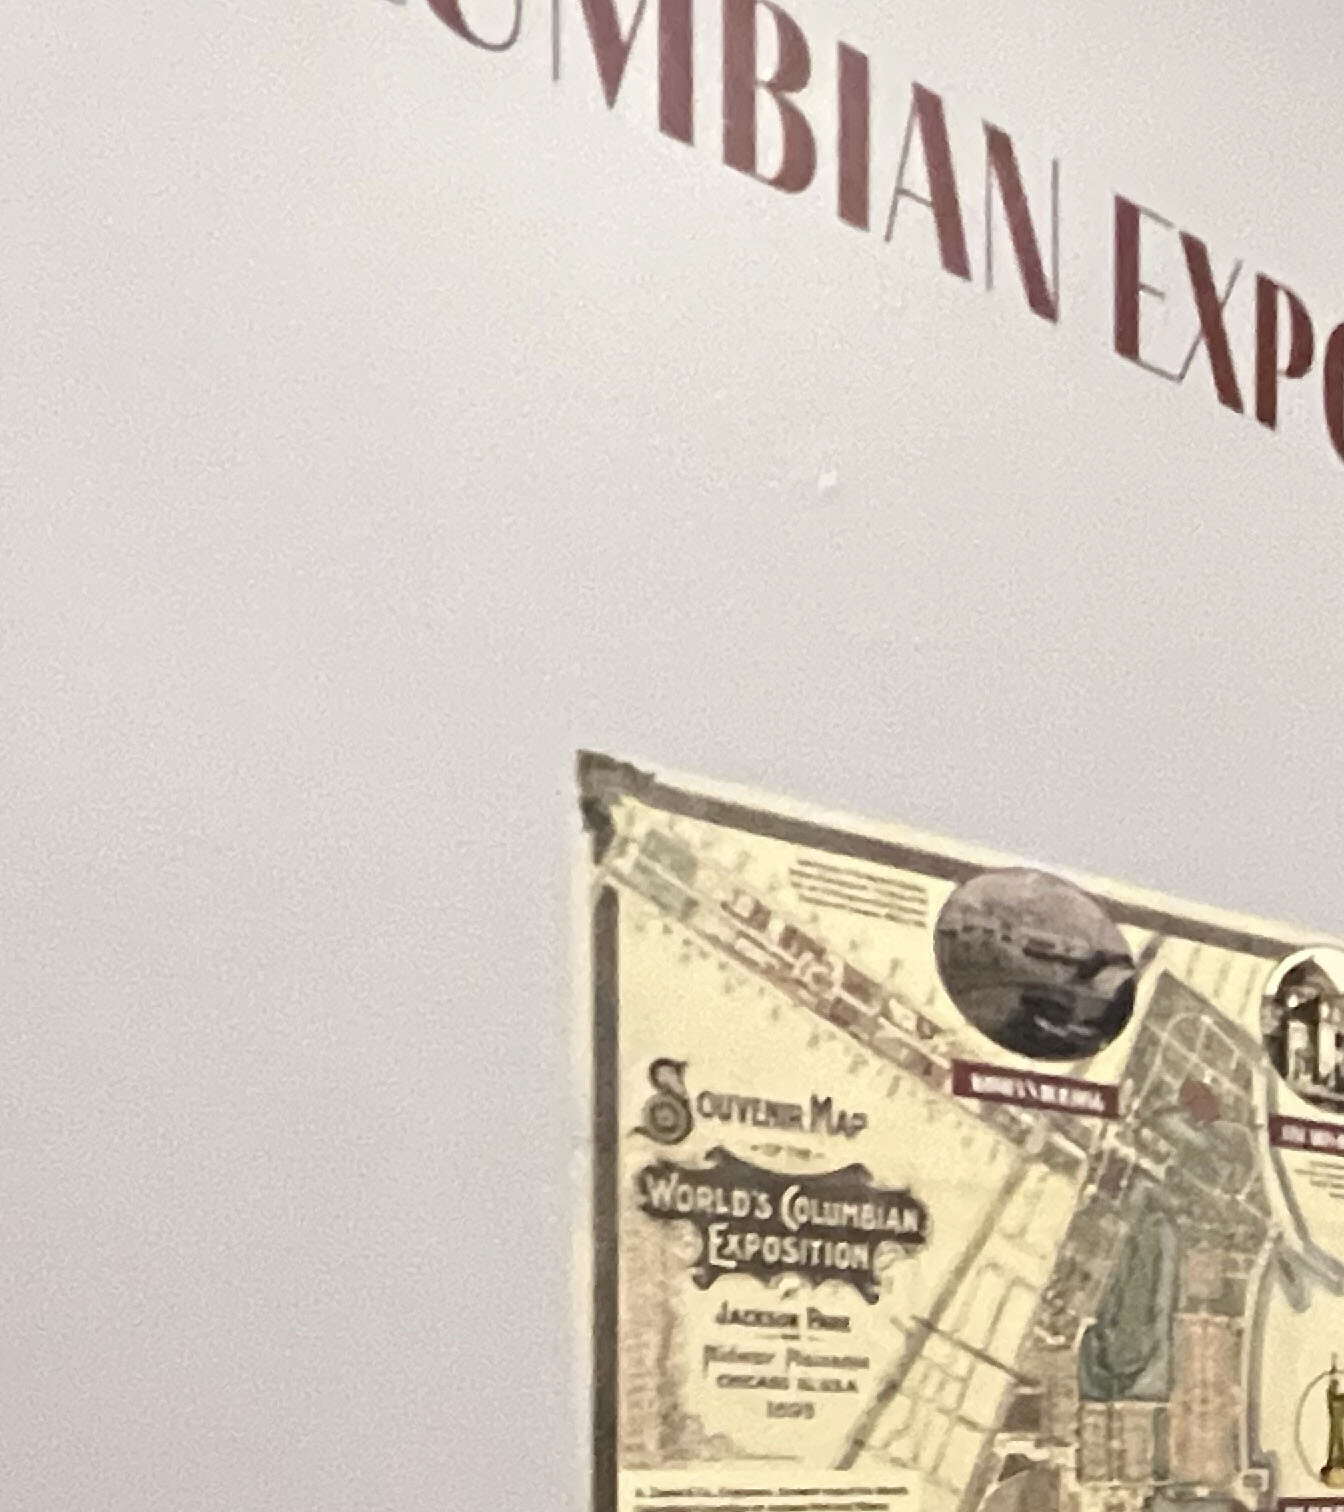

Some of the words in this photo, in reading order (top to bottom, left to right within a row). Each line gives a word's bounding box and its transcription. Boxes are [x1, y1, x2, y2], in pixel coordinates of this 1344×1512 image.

[425, 0, 1058, 324] MBIAN
[779, 1184, 920, 1233] COLUMBIAN
[708, 1222, 870, 1269] EXPOSITION
